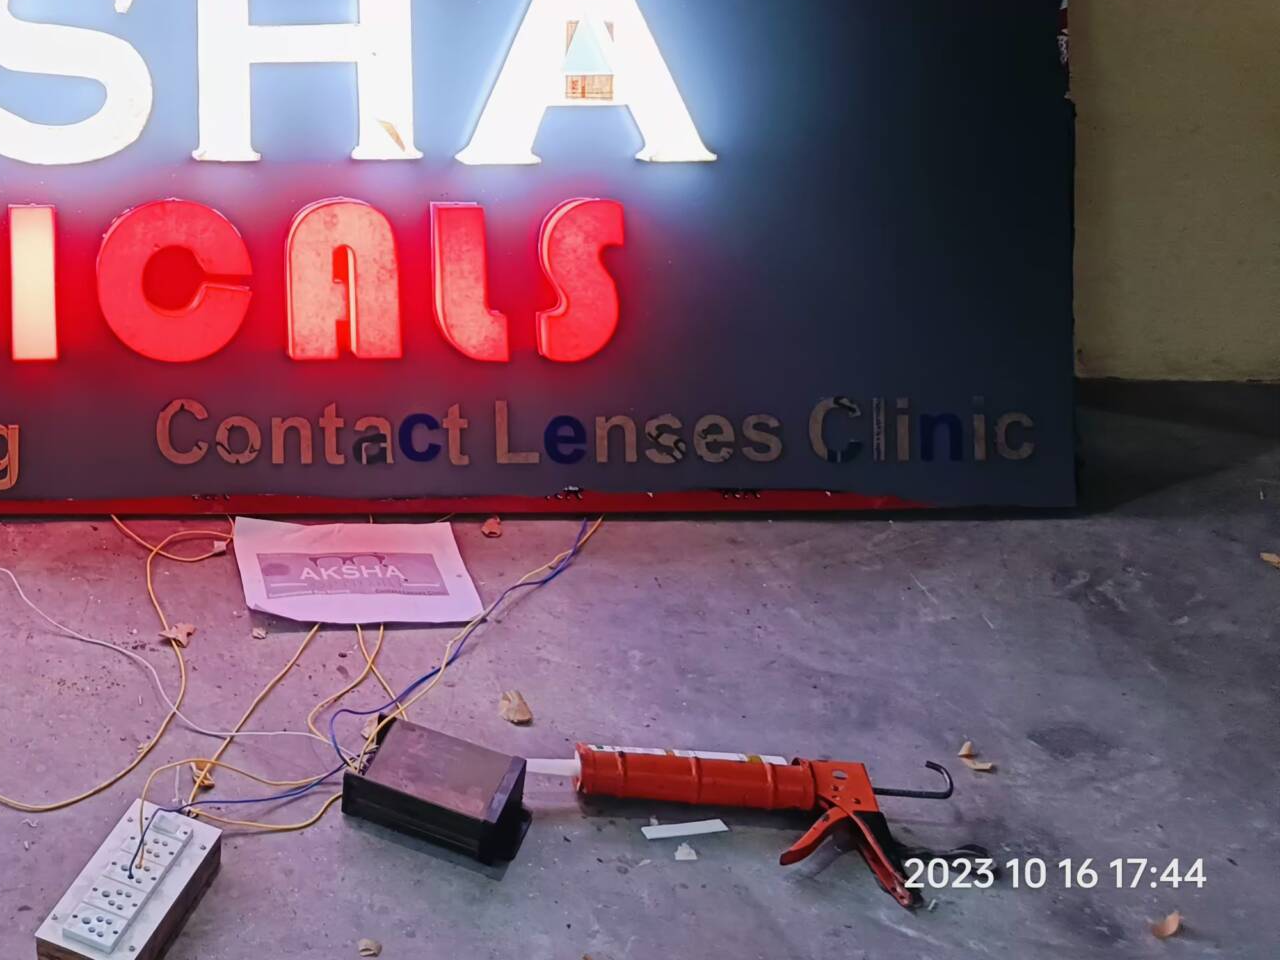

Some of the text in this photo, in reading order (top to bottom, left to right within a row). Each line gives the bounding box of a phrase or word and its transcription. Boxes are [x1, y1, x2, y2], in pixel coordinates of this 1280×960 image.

[155, 396, 1037, 467] Contact Lenses Clinic
[299, 565, 406, 581] AKSHA
